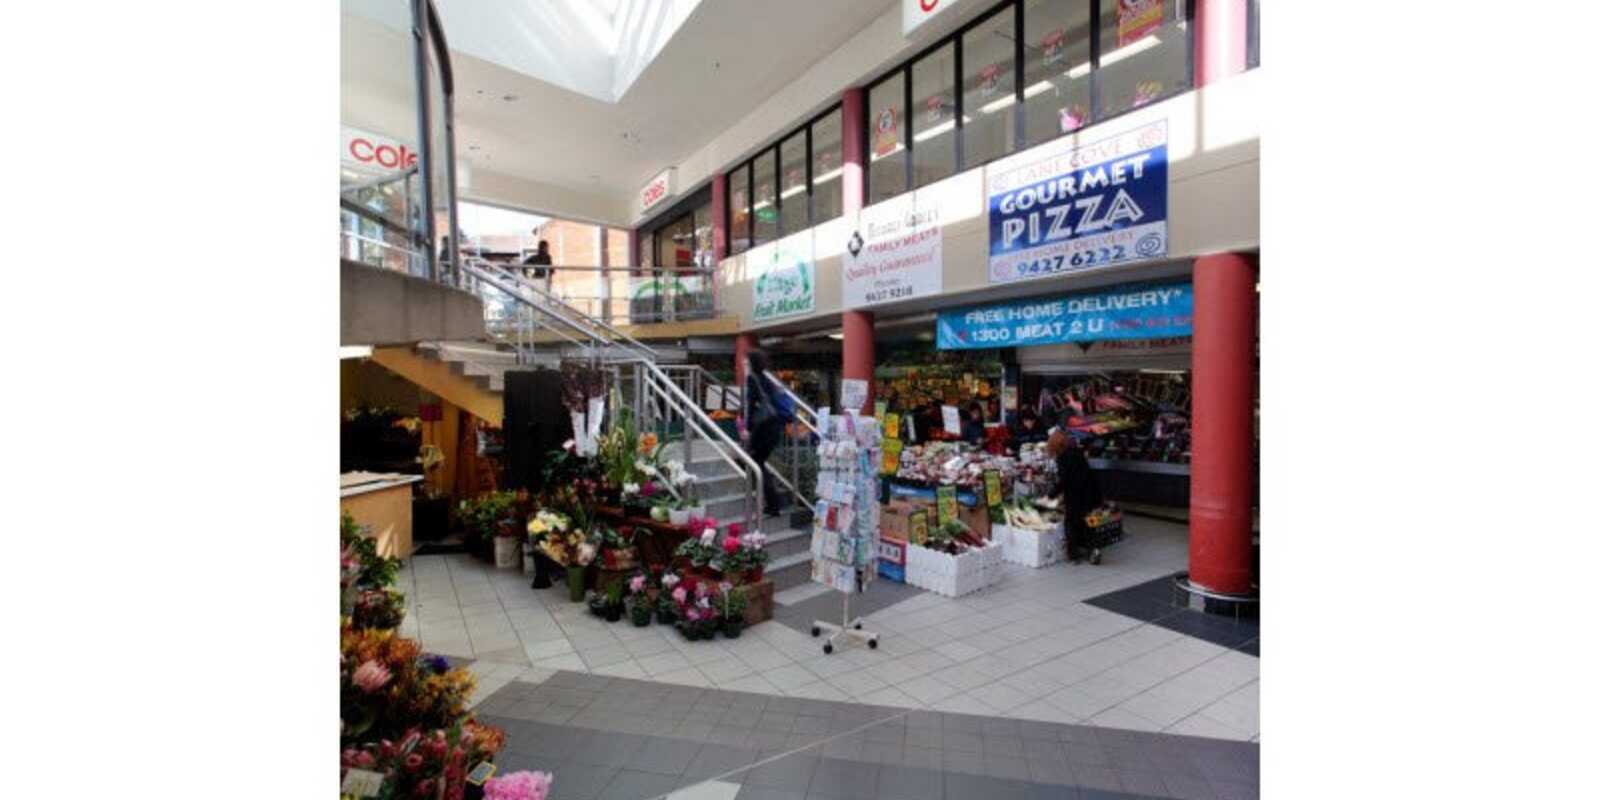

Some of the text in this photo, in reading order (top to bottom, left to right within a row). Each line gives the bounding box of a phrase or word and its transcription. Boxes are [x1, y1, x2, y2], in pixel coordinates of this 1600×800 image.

[1000, 154, 1151, 214] GOURMET
[1002, 188, 1144, 249] PIZZA
[904, 227, 939, 245] MEATS
[1017, 245, 1126, 274] 9427 6222
[778, 296, 813, 313] Market
[965, 307, 1002, 325] FREE
[1008, 302, 1064, 321] HOME
[972, 327, 1010, 342] 1300
[1015, 322, 1065, 340] MEAT
[1070, 321, 1083, 334] 2
[1087, 318, 1104, 333] U
